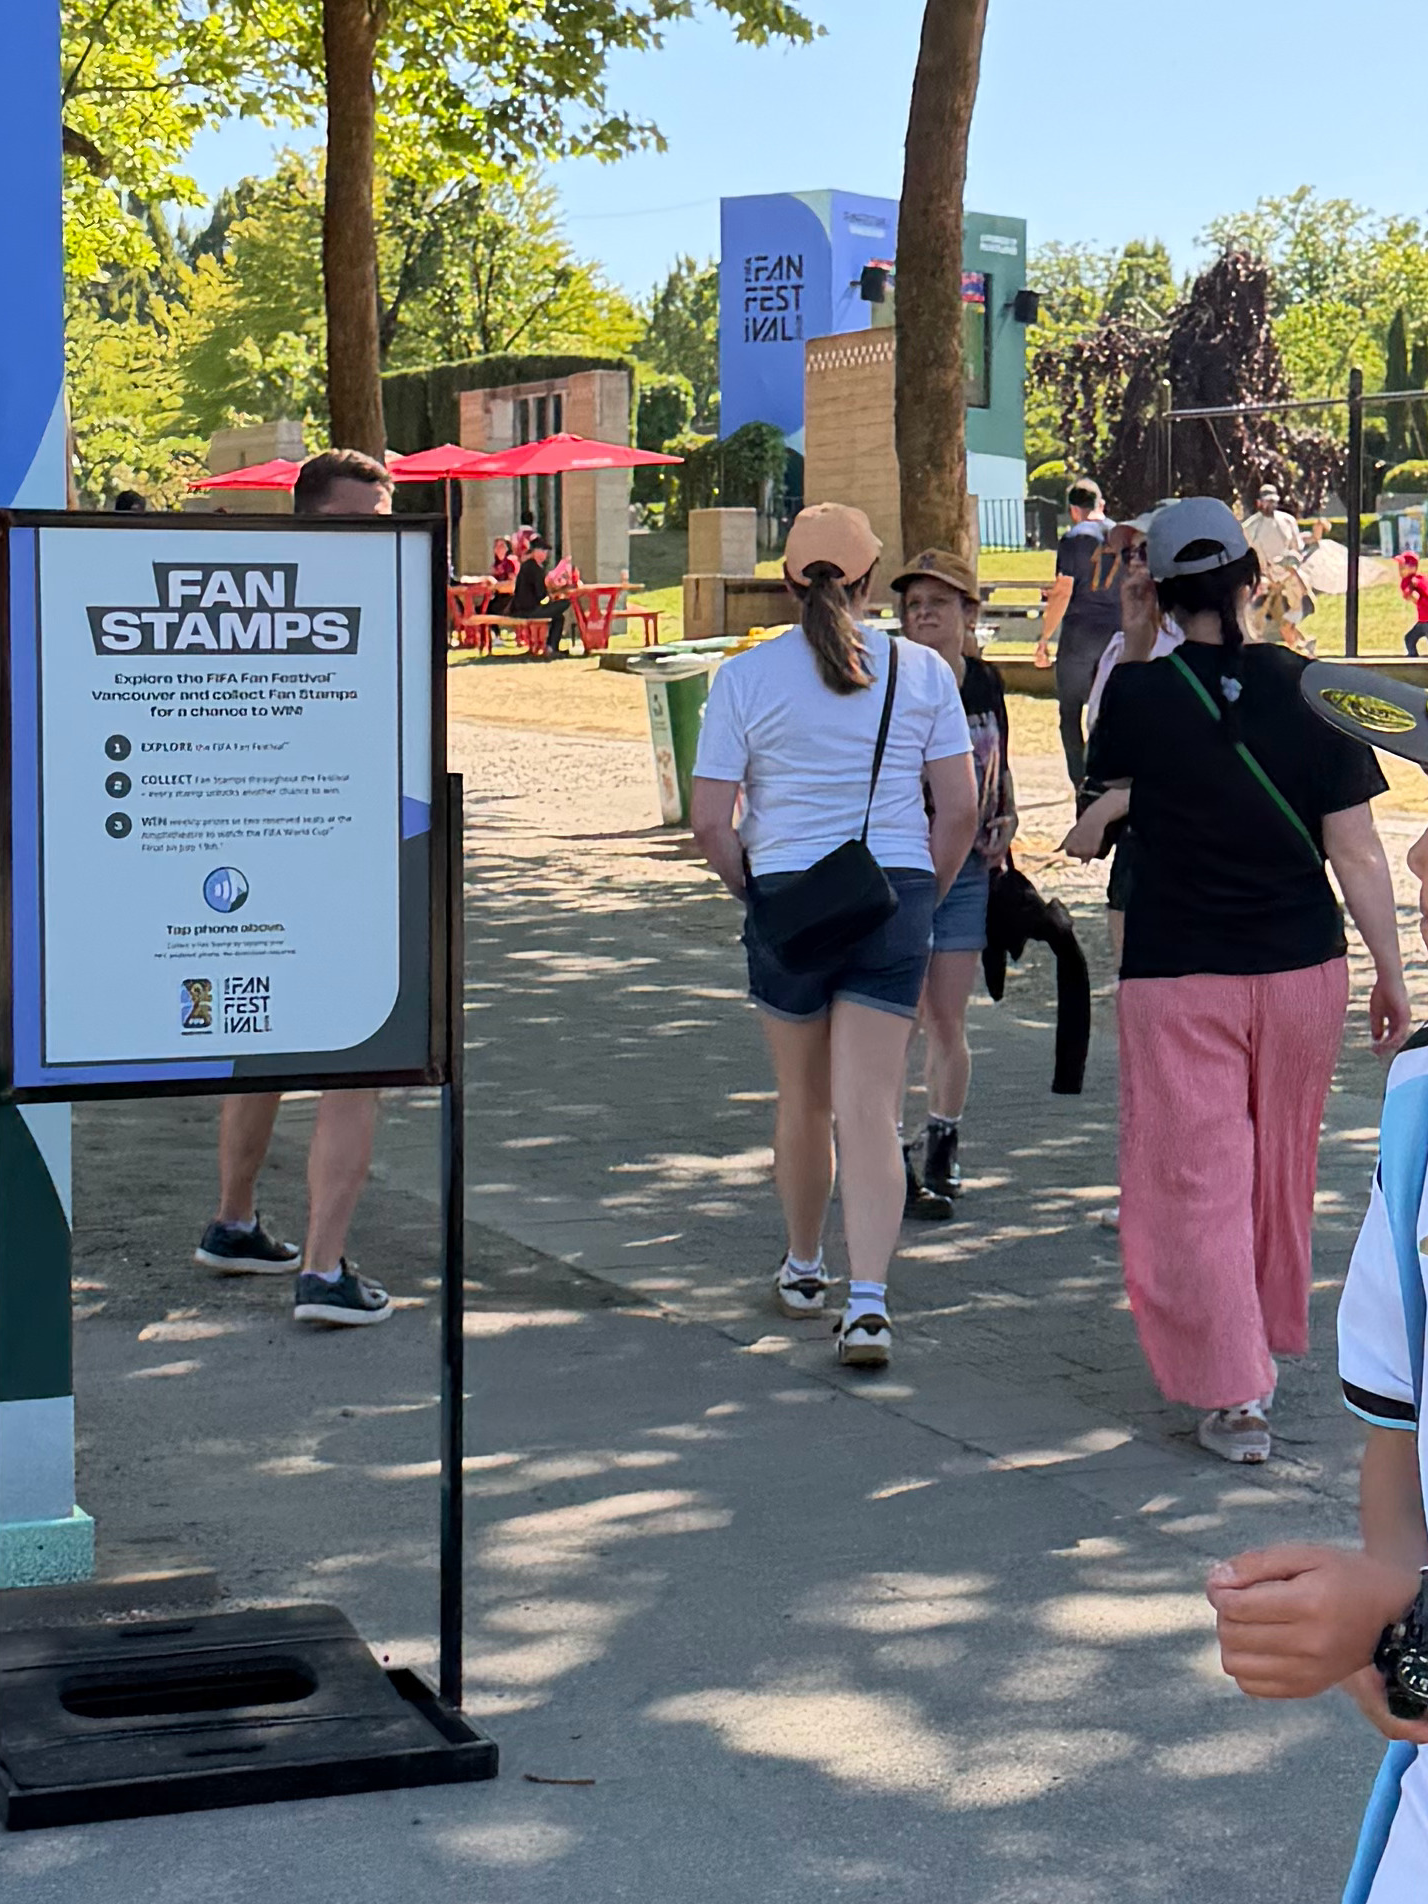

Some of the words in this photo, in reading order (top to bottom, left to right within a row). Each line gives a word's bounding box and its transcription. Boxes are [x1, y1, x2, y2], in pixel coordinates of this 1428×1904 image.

[754, 254, 803, 282] FAN
[745, 284, 804, 313] FEST
[168, 570, 285, 608] FAN
[101, 611, 350, 651] STAMPS
[114, 673, 172, 687] Explore
[177, 673, 203, 684] the
[206, 672, 238, 684] FIFA
[241, 672, 268, 684] Fan
[91, 689, 175, 701] Vancouver
[179, 689, 210, 701] and
[212, 689, 266, 701] collect
[269, 689, 296, 701] Fan
[299, 689, 358, 701] Stamps
[150, 705, 175, 717] for
[177, 708, 187, 717] a
[190, 705, 248, 717] chance
[251, 706, 268, 716] to
[141, 742, 193, 752] EXPLORE
[114, 780, 122, 790] 2
[141, 774, 193, 785] COLLECT
[114, 820, 123, 831] 3
[141, 816, 168, 827] WIN
[166, 924, 191, 936] Tap
[193, 924, 239, 936] phone
[232, 976, 270, 994] FAN
[224, 996, 270, 1014] FEST
